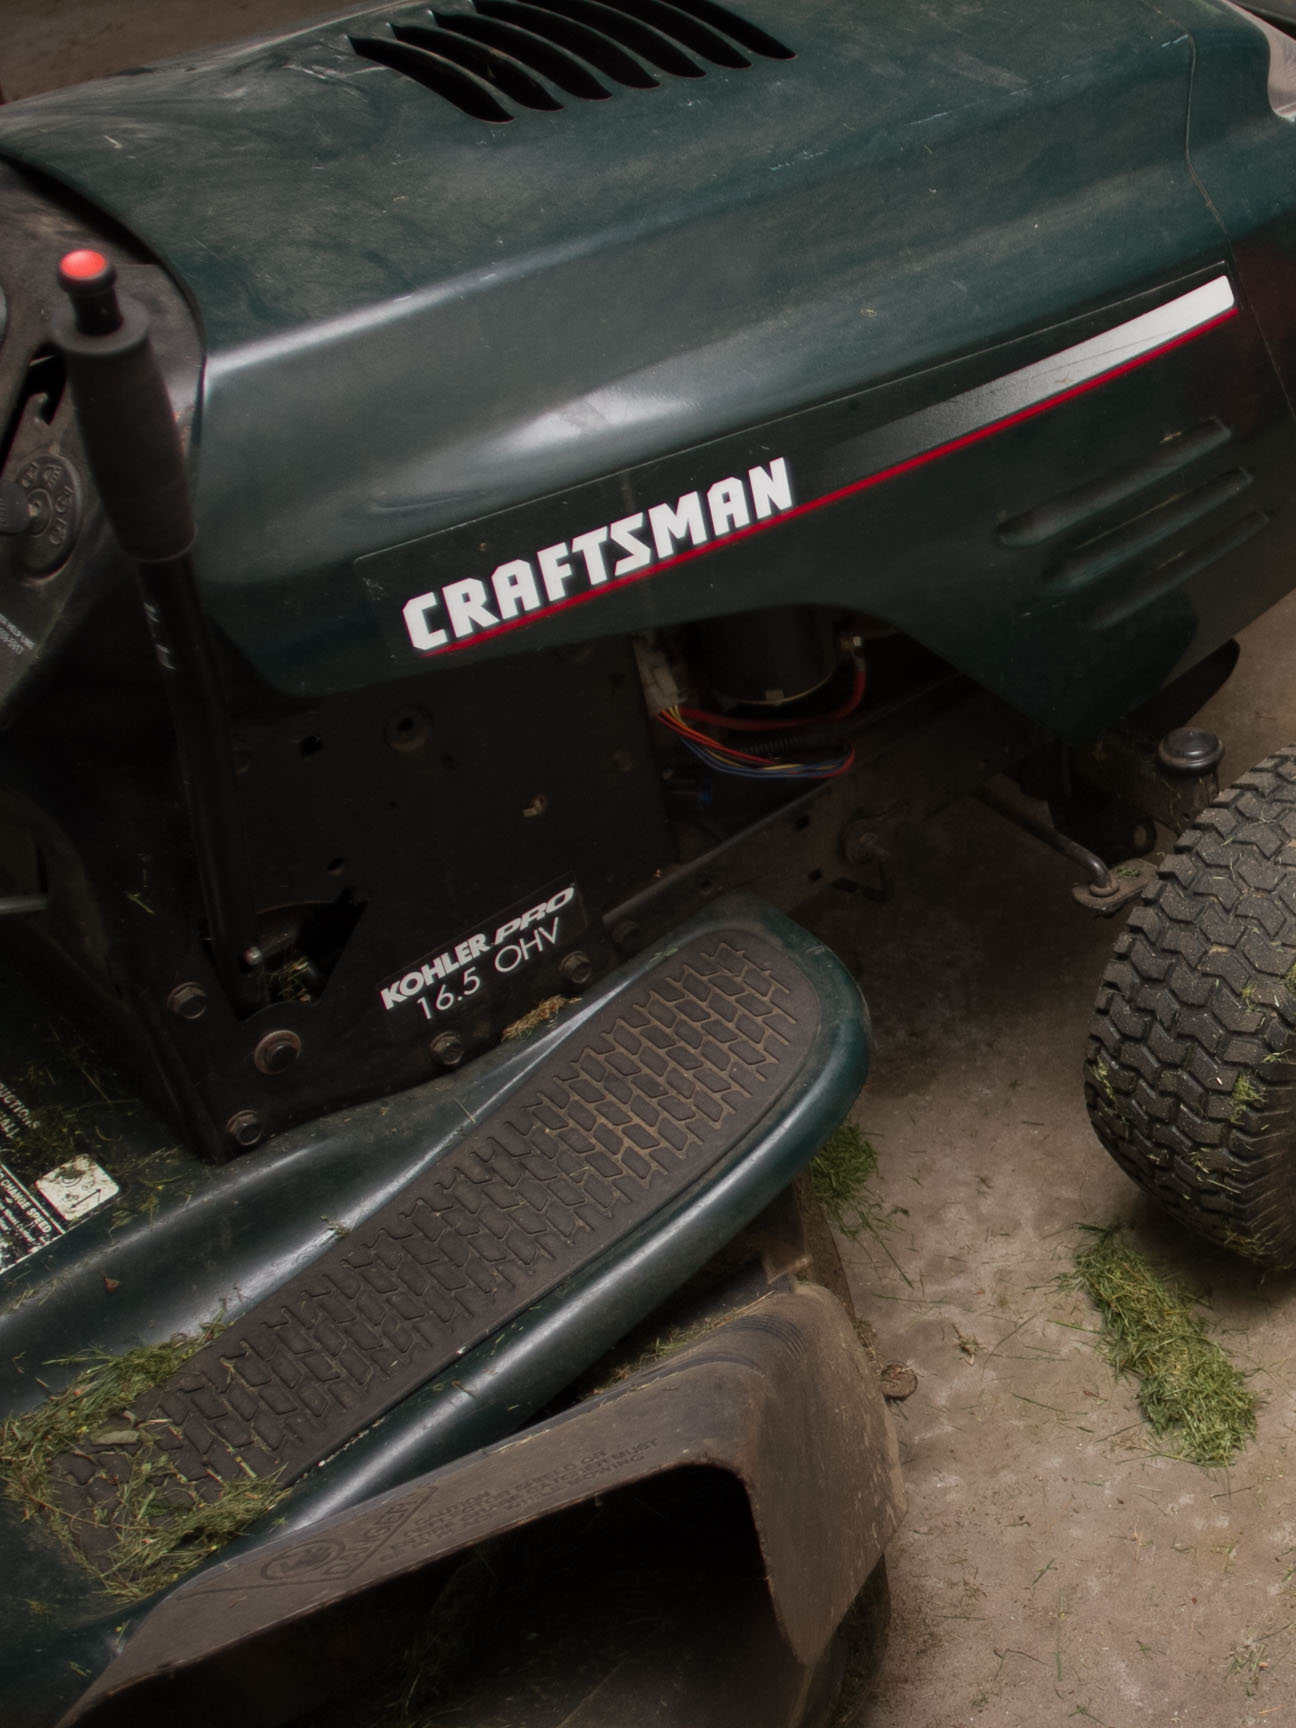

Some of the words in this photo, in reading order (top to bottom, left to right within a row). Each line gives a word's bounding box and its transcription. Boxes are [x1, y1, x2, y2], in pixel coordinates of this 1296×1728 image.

[402, 456, 794, 651] CRAFTSMAN
[380, 932, 491, 1011] KOHLER
[494, 886, 575, 945] PRO
[416, 966, 481, 1020] 16.5
[494, 916, 559, 973] OHV
[1, 1178, 31, 1211] CHANGE
[26, 1204, 52, 1233] SPEED
